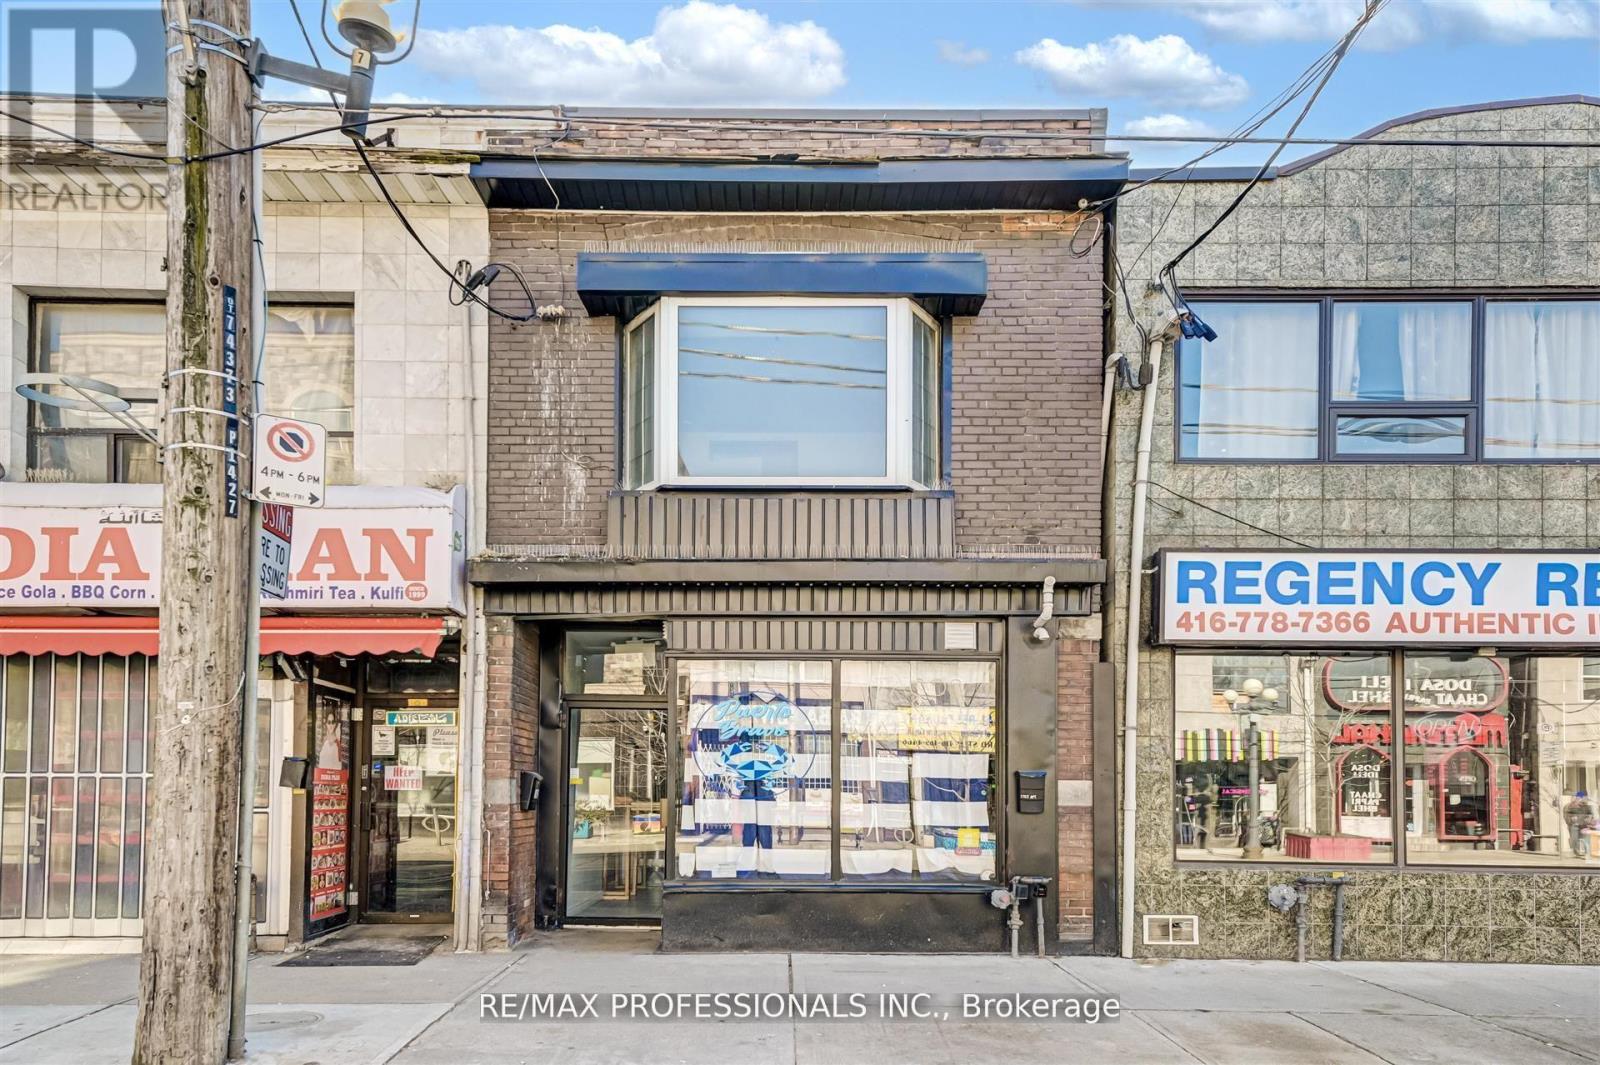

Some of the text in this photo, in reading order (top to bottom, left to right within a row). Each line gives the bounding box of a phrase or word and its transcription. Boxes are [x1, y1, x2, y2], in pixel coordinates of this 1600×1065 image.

[357, 52, 364, 64] 7
[276, 544, 286, 565] TO
[289, 528, 434, 581] AN
[21, 585, 56, 599] Gola
[71, 585, 104, 600] BBQ
[110, 585, 146, 599] Corn
[328, 586, 356, 600] Tea
[371, 586, 404, 600] Kulfi
[1176, 560, 1502, 607] REGENCY
[1176, 611, 1370, 633] 416-778-7366
[1386, 612, 1576, 635] AUTHENTIC
